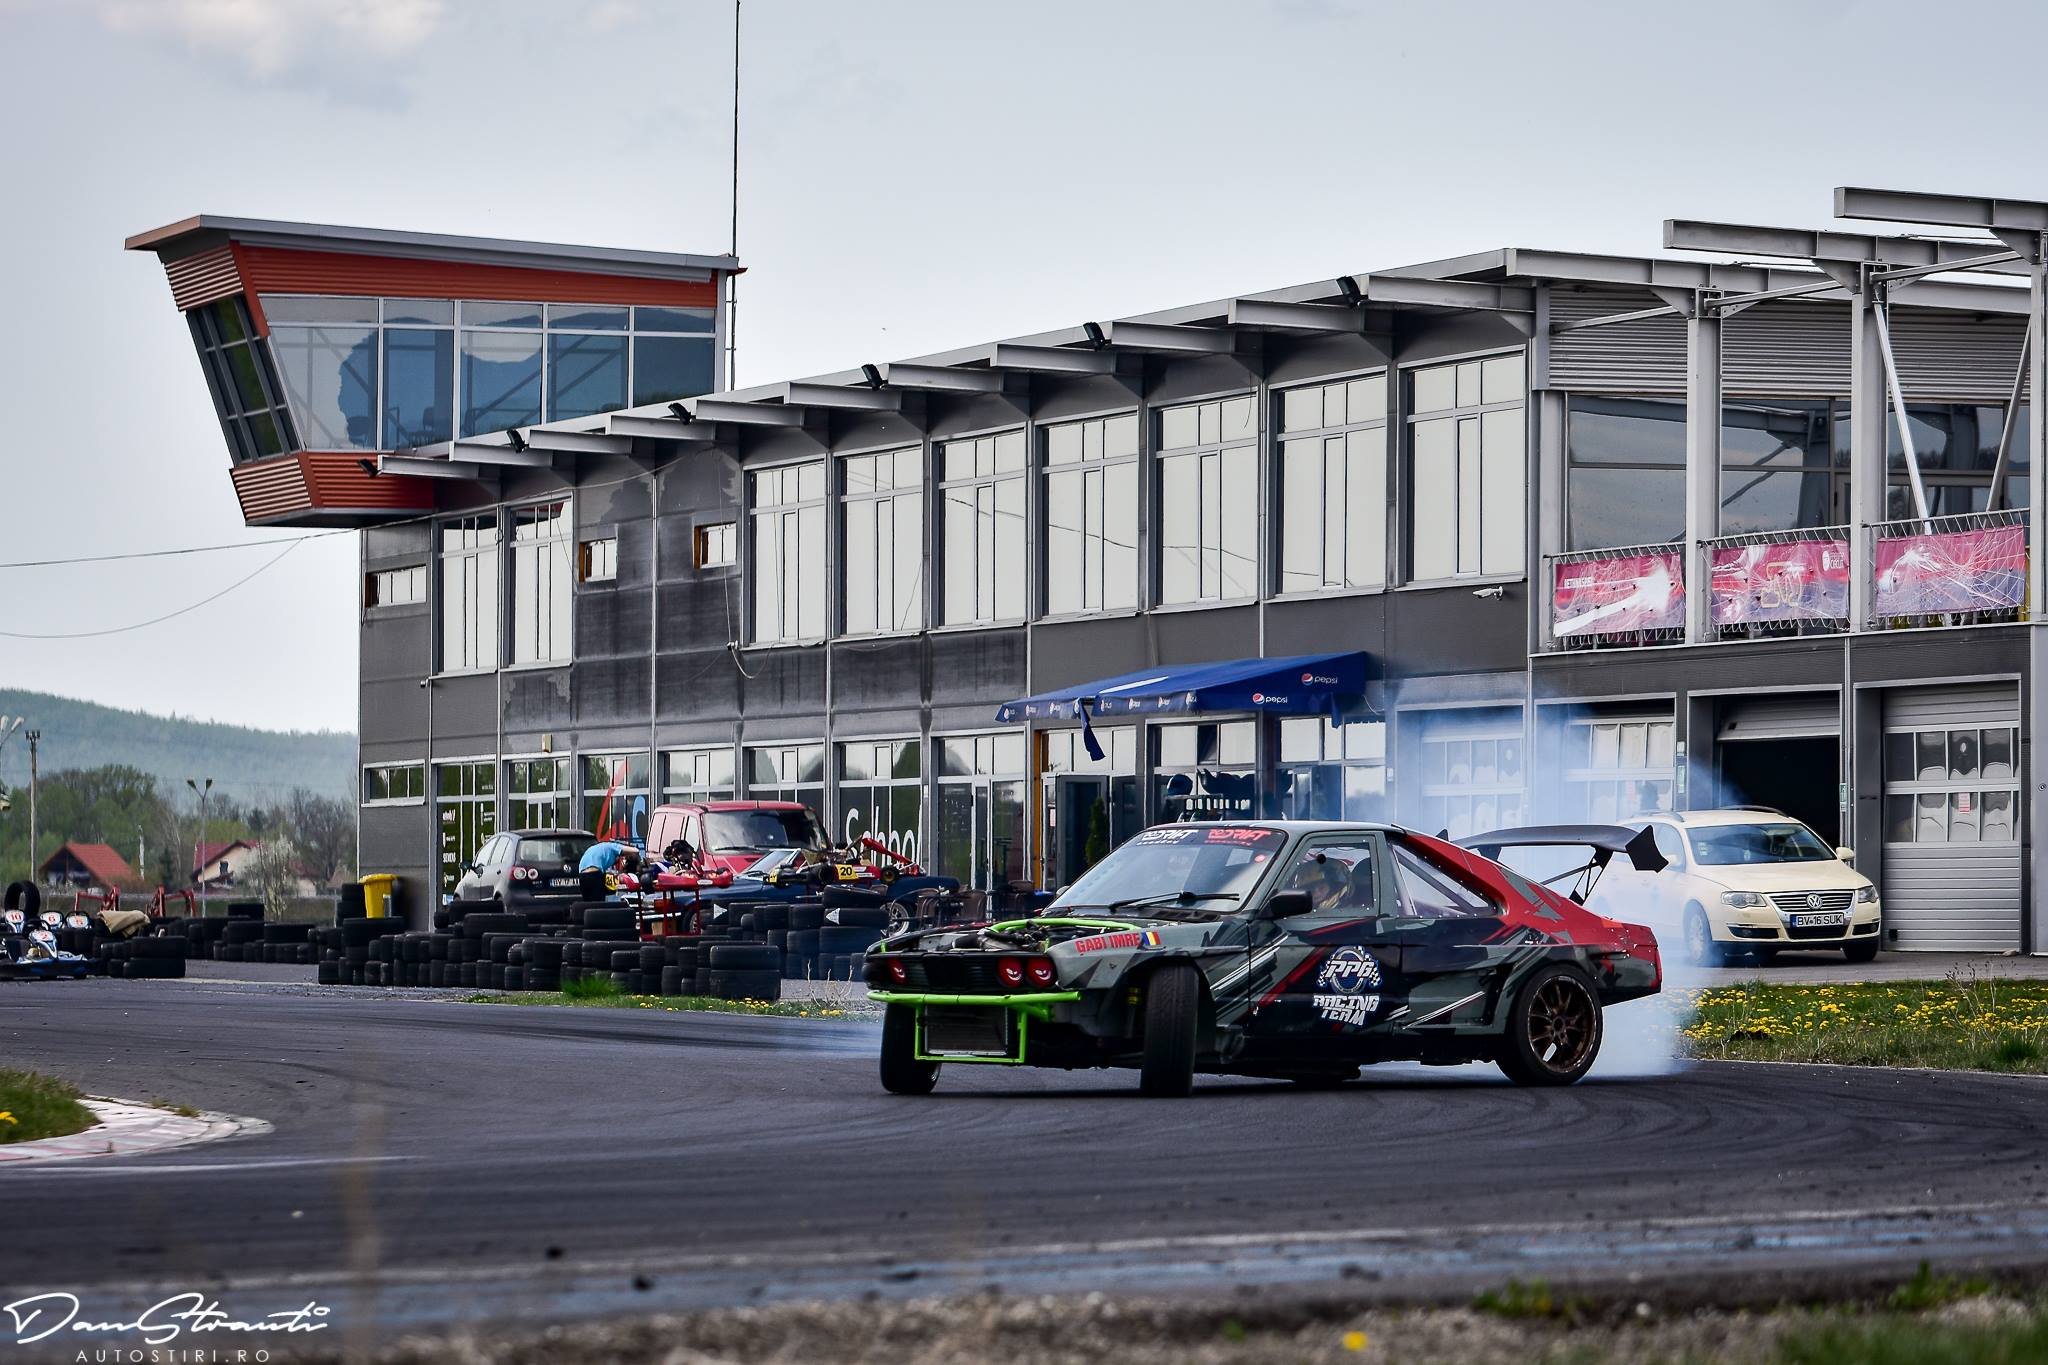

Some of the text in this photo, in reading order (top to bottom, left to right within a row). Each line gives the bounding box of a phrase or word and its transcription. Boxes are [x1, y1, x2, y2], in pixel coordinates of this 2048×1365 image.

[1314, 676, 1338, 684] pepsi
[1265, 696, 1288, 704] pepsi
[840, 866, 853, 877] 20
[1797, 915, 1842, 925] BV 16 SUK
[1075, 932, 1140, 953] GABI IMRE
[1325, 960, 1375, 978] PPG
[1312, 995, 1380, 1012] RACING
[1320, 1006, 1366, 1026] TEAM
